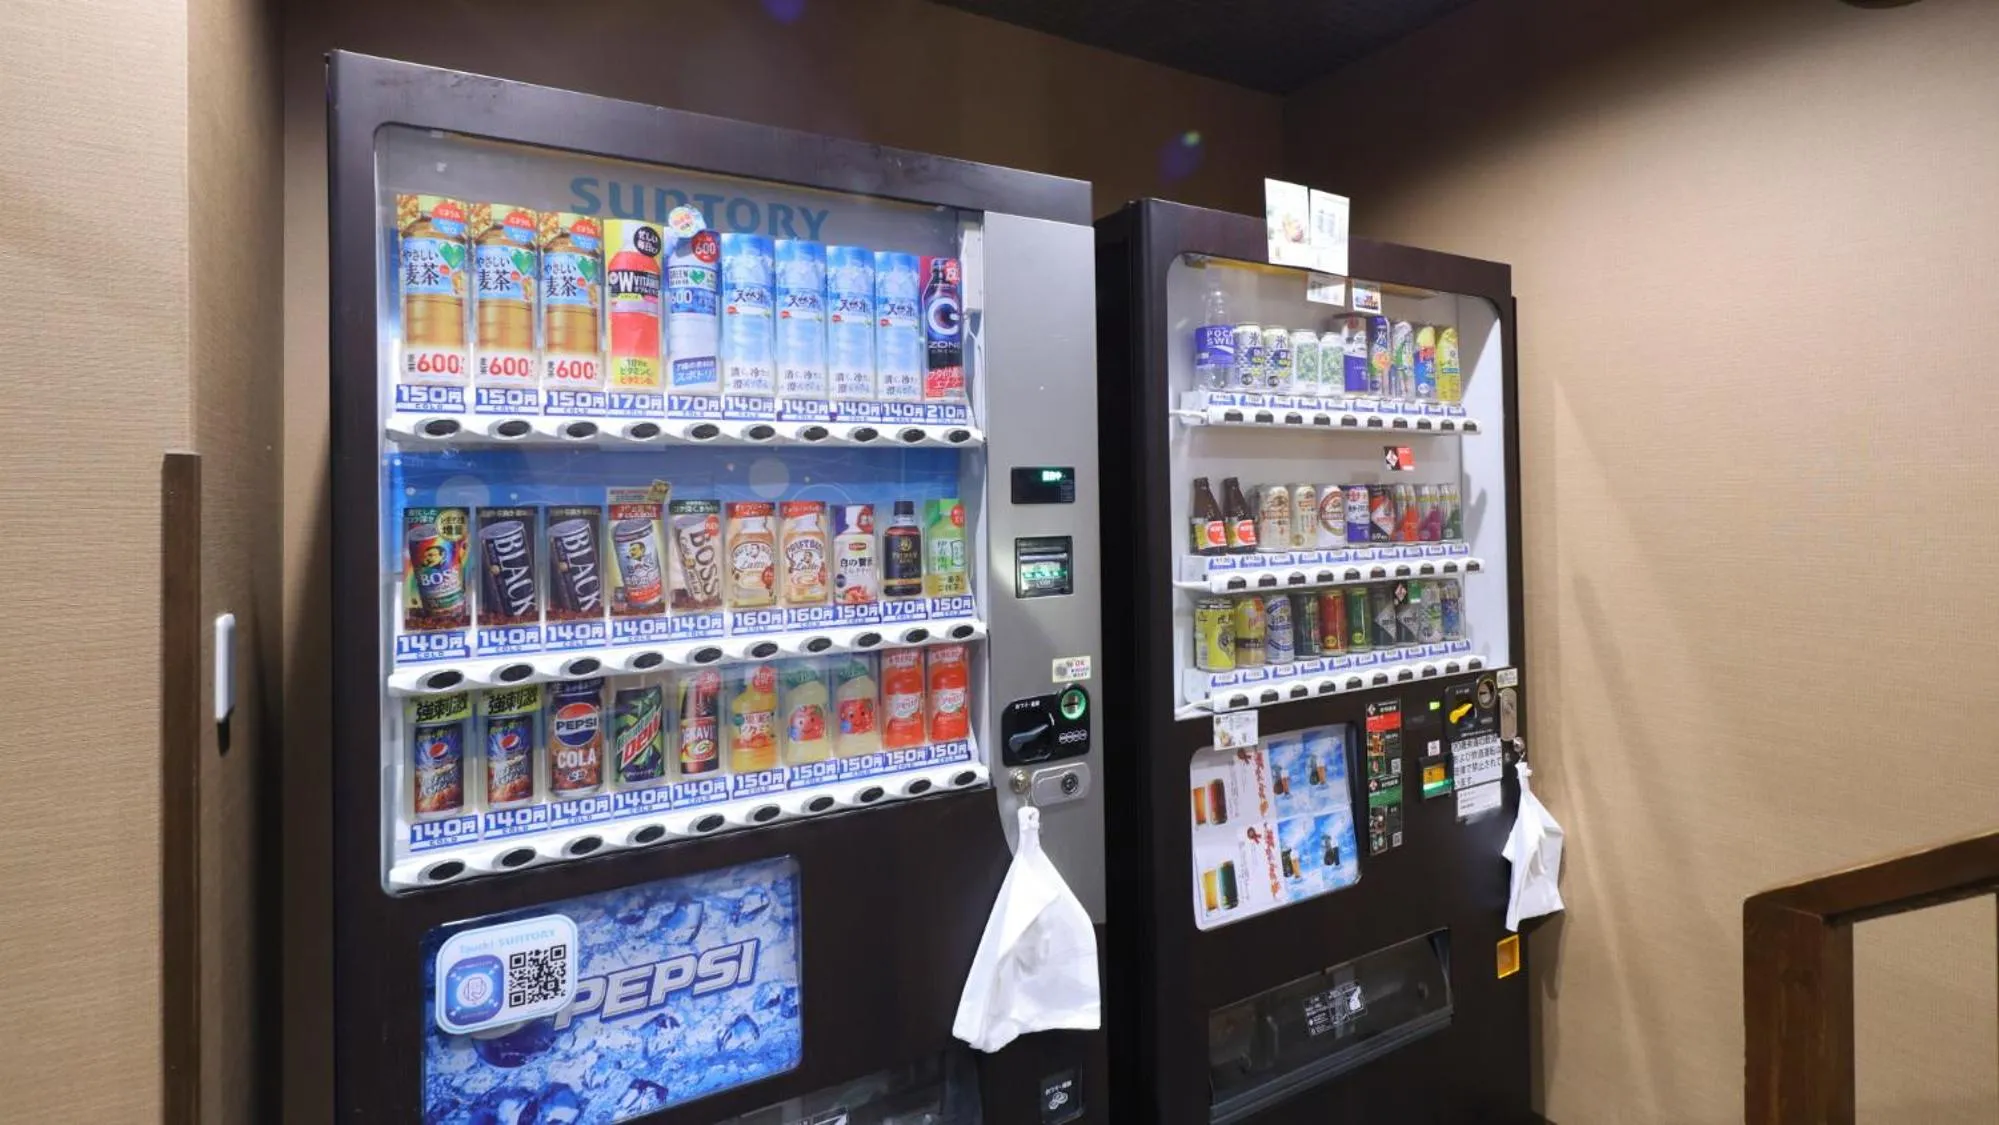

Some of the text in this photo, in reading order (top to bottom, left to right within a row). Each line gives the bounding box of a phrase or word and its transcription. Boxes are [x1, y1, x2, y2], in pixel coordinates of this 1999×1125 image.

[570, 177, 829, 241] SUNTORY
[403, 248, 439, 262] やさしい
[478, 256, 511, 268] やさしい
[405, 262, 439, 286] 麦茶
[544, 262, 577, 274] やさしい
[479, 269, 512, 292] 麦茶
[545, 276, 578, 298] 麦茶
[417, 353, 460, 374] 600
[489, 356, 529, 377] 600
[556, 359, 595, 380] 600
[399, 385, 463, 404] 150円
[479, 387, 537, 406] 150円
[549, 390, 605, 407] 150円
[611, 393, 662, 408] 170円
[671, 395, 720, 410] 170円
[727, 398, 774, 412] 140円
[784, 400, 828, 414] 140円
[838, 402, 880, 416] 140円
[883, 403, 924, 417] 140円
[926, 405, 966, 418] 210円
[561, 530, 601, 612] BLACK
[690, 533, 719, 595] BOSS
[419, 568, 459, 586] BOSS
[493, 531, 537, 616] BLACK
[835, 606, 878, 620] 150円
[885, 602, 925, 616] 170円
[933, 598, 972, 612] 150円
[735, 612, 783, 626] 160円
[788, 609, 833, 623] 160円
[548, 625, 604, 642] 140円
[614, 621, 666, 637] 140円
[672, 616, 722, 634] 140円
[399, 633, 463, 652] 140円
[480, 629, 539, 647] 140円
[556, 717, 597, 730] PEPSI
[557, 748, 597, 769] COLA
[885, 749, 926, 765] 150円
[927, 742, 967, 758] 150円
[793, 763, 838, 780] 150円
[841, 755, 882, 773] 150円
[736, 771, 784, 788] 150円
[615, 790, 669, 807] 140円
[674, 780, 726, 800] 140円
[552, 799, 610, 817] 140円
[485, 809, 547, 829] 140円
[412, 820, 477, 837] 140円
[554, 938, 761, 1031] PEPSI
